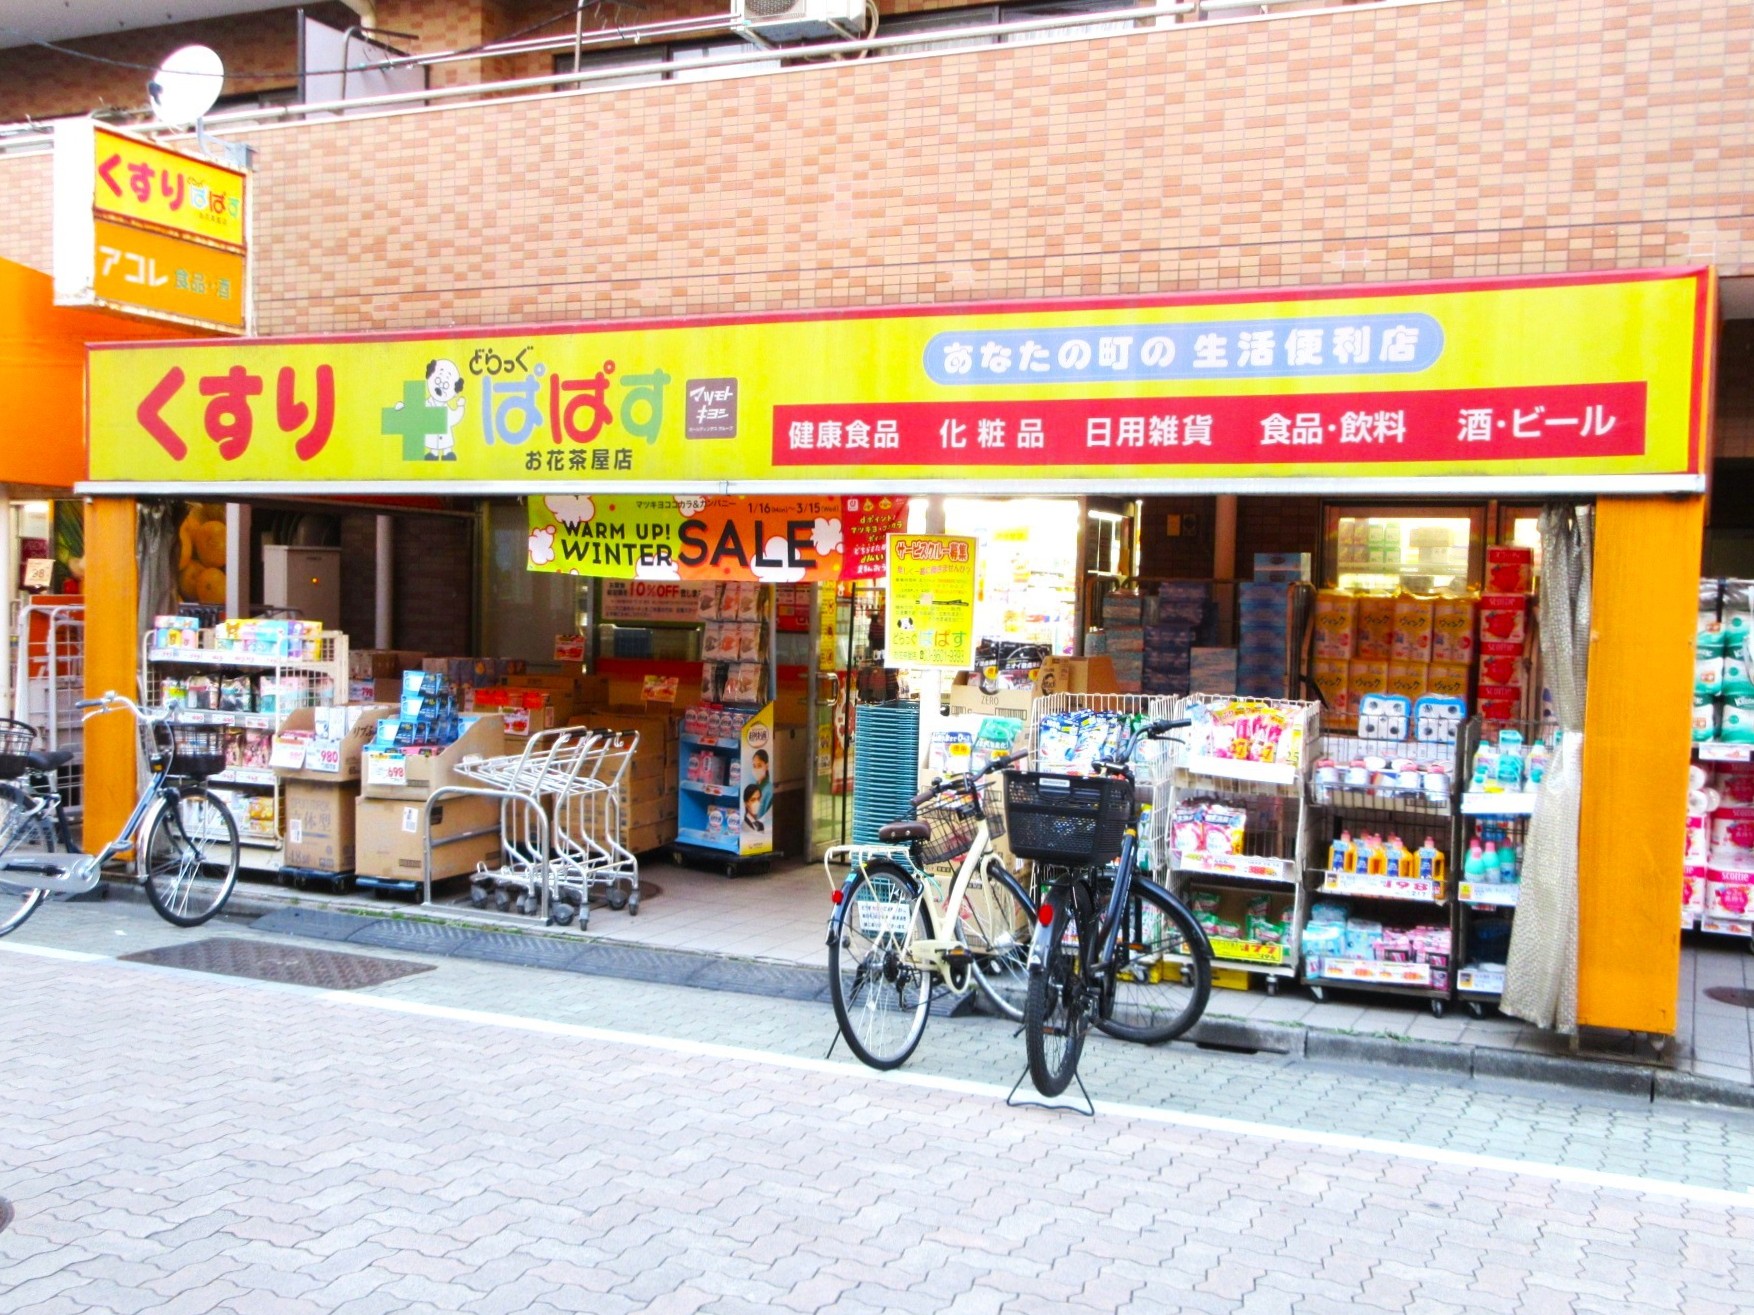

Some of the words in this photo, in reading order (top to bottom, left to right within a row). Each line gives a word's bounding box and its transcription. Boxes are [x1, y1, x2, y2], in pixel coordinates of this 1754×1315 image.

[98, 153, 185, 212] くすり
[99, 245, 169, 287] アコレ
[1192, 324, 1421, 369] 生活便利店
[468, 346, 535, 376] どらっぐ
[481, 359, 673, 446] ぱぱす
[689, 385, 734, 406] マツモト
[136, 364, 336, 462] くすり
[695, 404, 730, 425] キヨシ
[787, 419, 901, 450] 健康食品
[938, 417, 1046, 450] 化粧品
[1085, 414, 1214, 449] 日用雑貨
[524, 447, 634, 473] お花茶屋店
[561, 520, 627, 541] WARM
[635, 522, 671, 540] UP!
[677, 518, 817, 569] SALE
[561, 539, 673, 567] WINTER
[629, 581, 680, 599] 10%OFF
[980, 695, 1000, 706] ZERO
[320, 749, 339, 763] 980
[387, 766, 405, 777] 698
[1384, 880, 1429, 892] 198
[1243, 943, 1277, 955] 177
